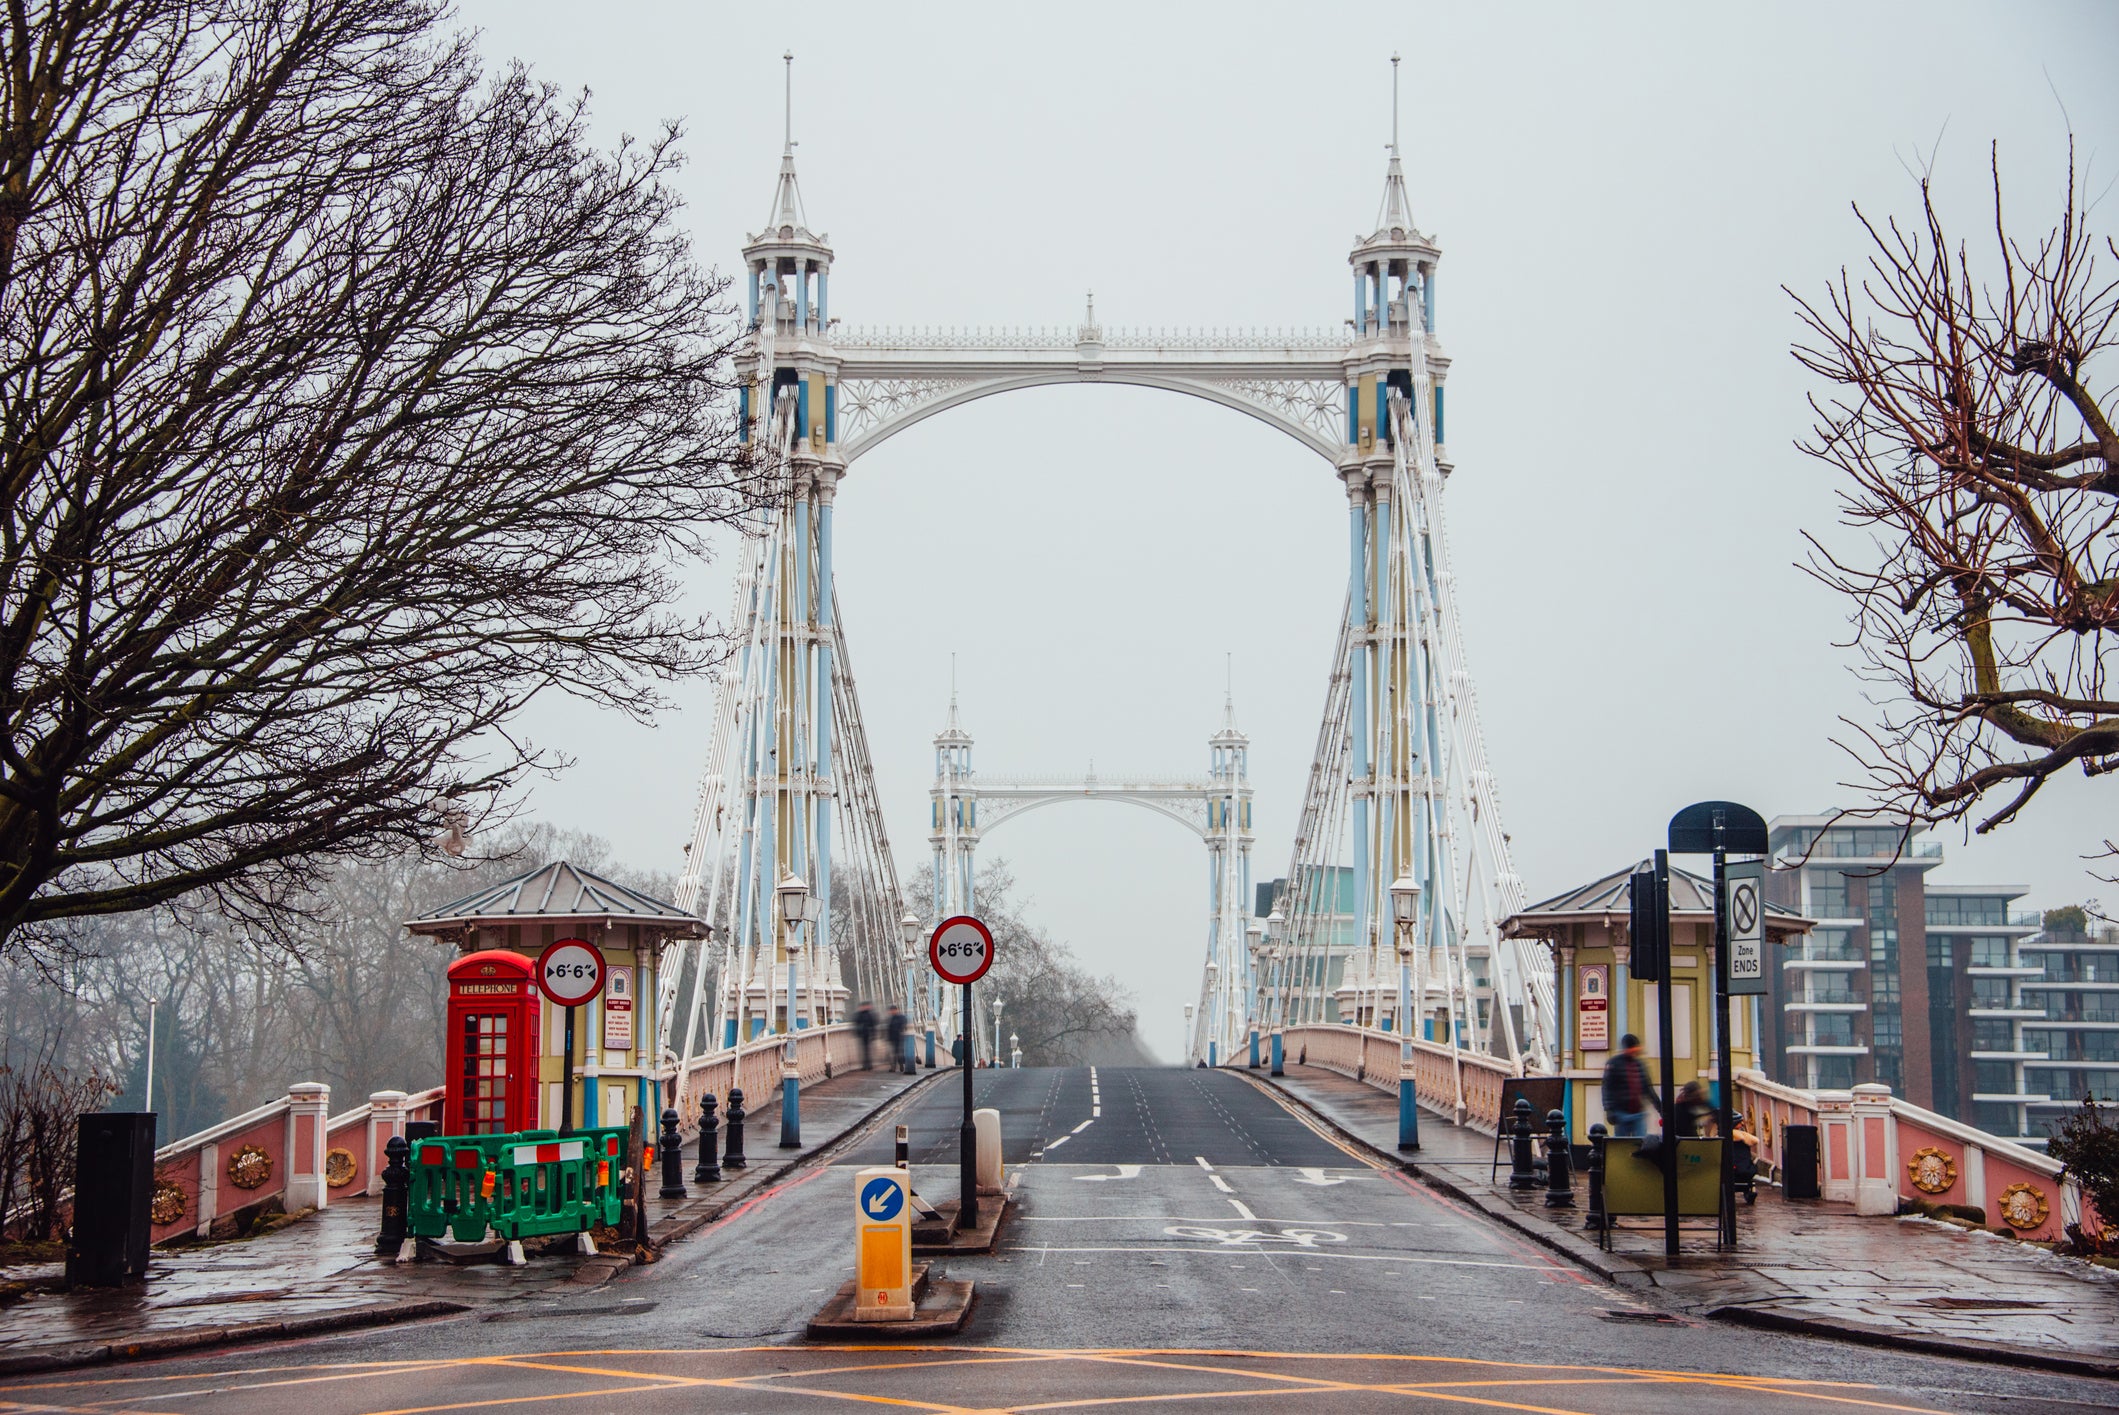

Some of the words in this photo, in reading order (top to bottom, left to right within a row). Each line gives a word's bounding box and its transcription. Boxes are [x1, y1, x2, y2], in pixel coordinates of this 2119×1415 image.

[1738, 945, 1753, 956] Zone
[1734, 959, 1758, 973] ENDS
[460, 984, 516, 994] TELEPHONE
